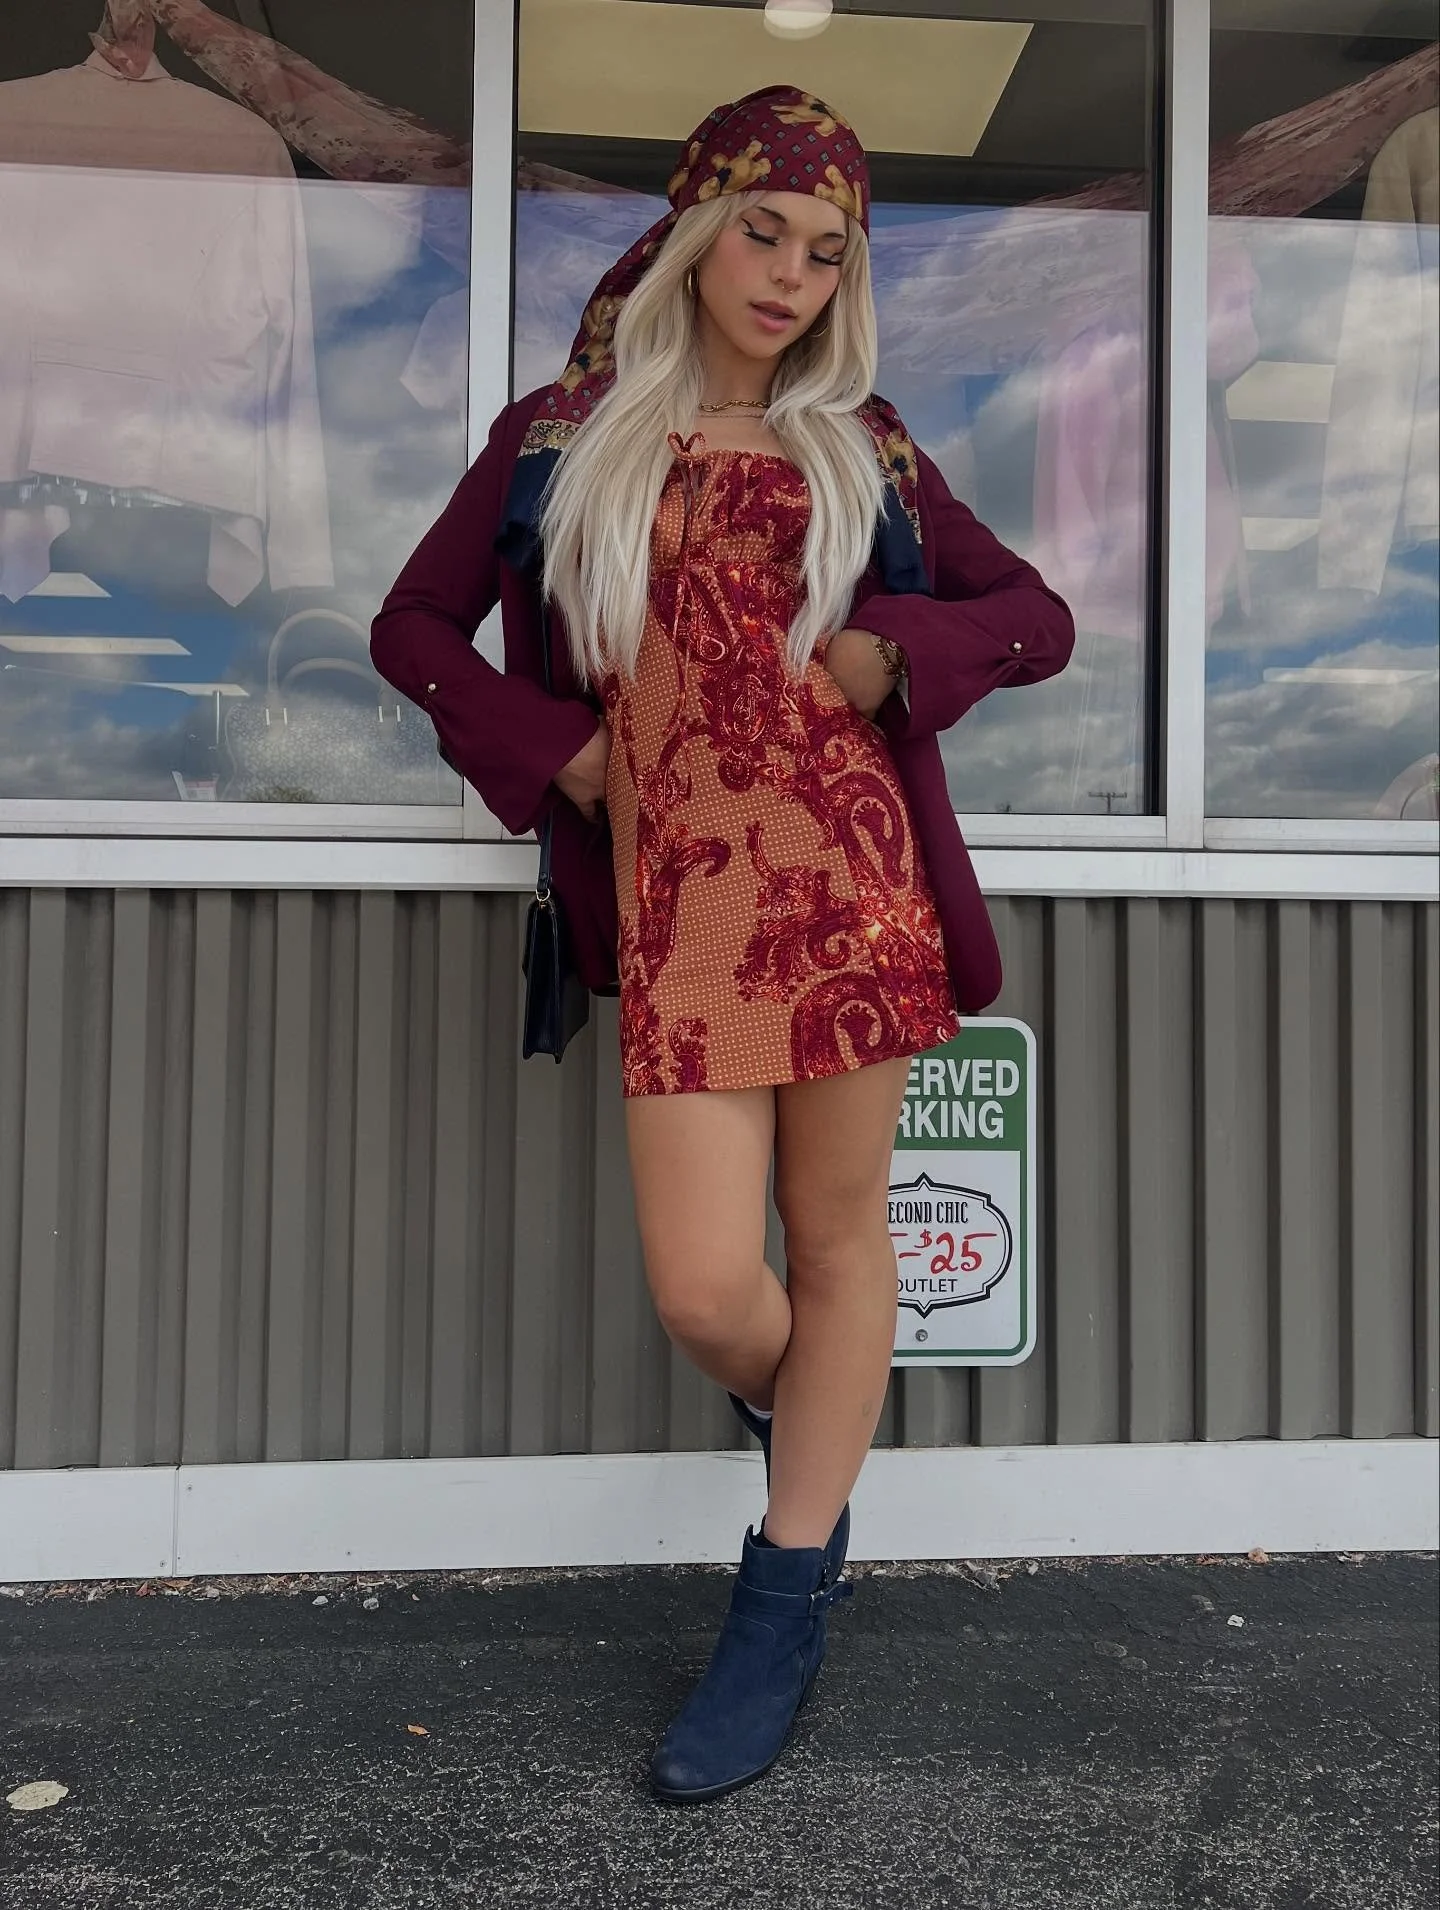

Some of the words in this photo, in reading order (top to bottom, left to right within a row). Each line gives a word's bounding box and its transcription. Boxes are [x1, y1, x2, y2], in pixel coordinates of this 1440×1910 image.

[888, 1201, 932, 1224] ECOND
[936, 1201, 968, 1224] CHIC
[890, 1229, 997, 1274] -$25
